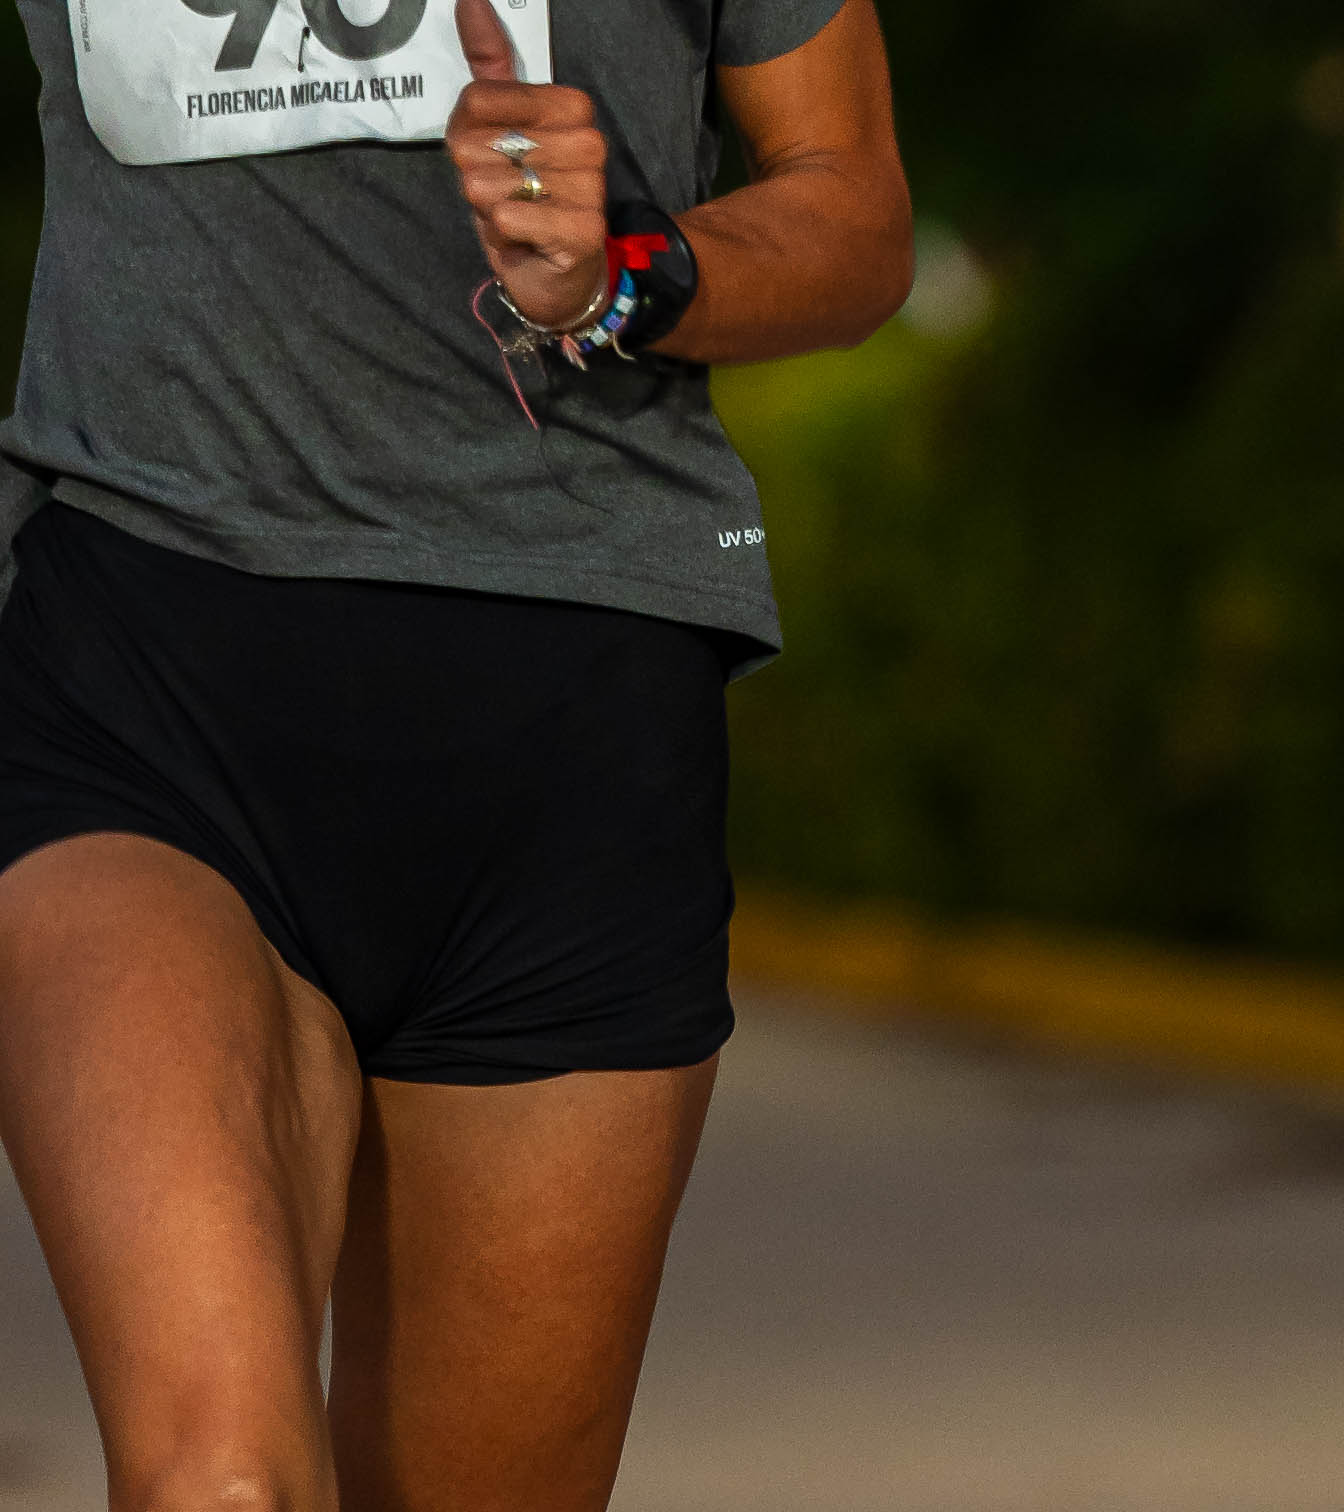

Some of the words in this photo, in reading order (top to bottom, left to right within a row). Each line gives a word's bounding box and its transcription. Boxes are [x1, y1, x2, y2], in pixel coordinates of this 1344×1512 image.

[187, 86, 286, 119] FLORENCIA
[290, 79, 365, 108] MICAELA
[369, 74, 424, 101] GELMI
[718, 530, 741, 548] UV
